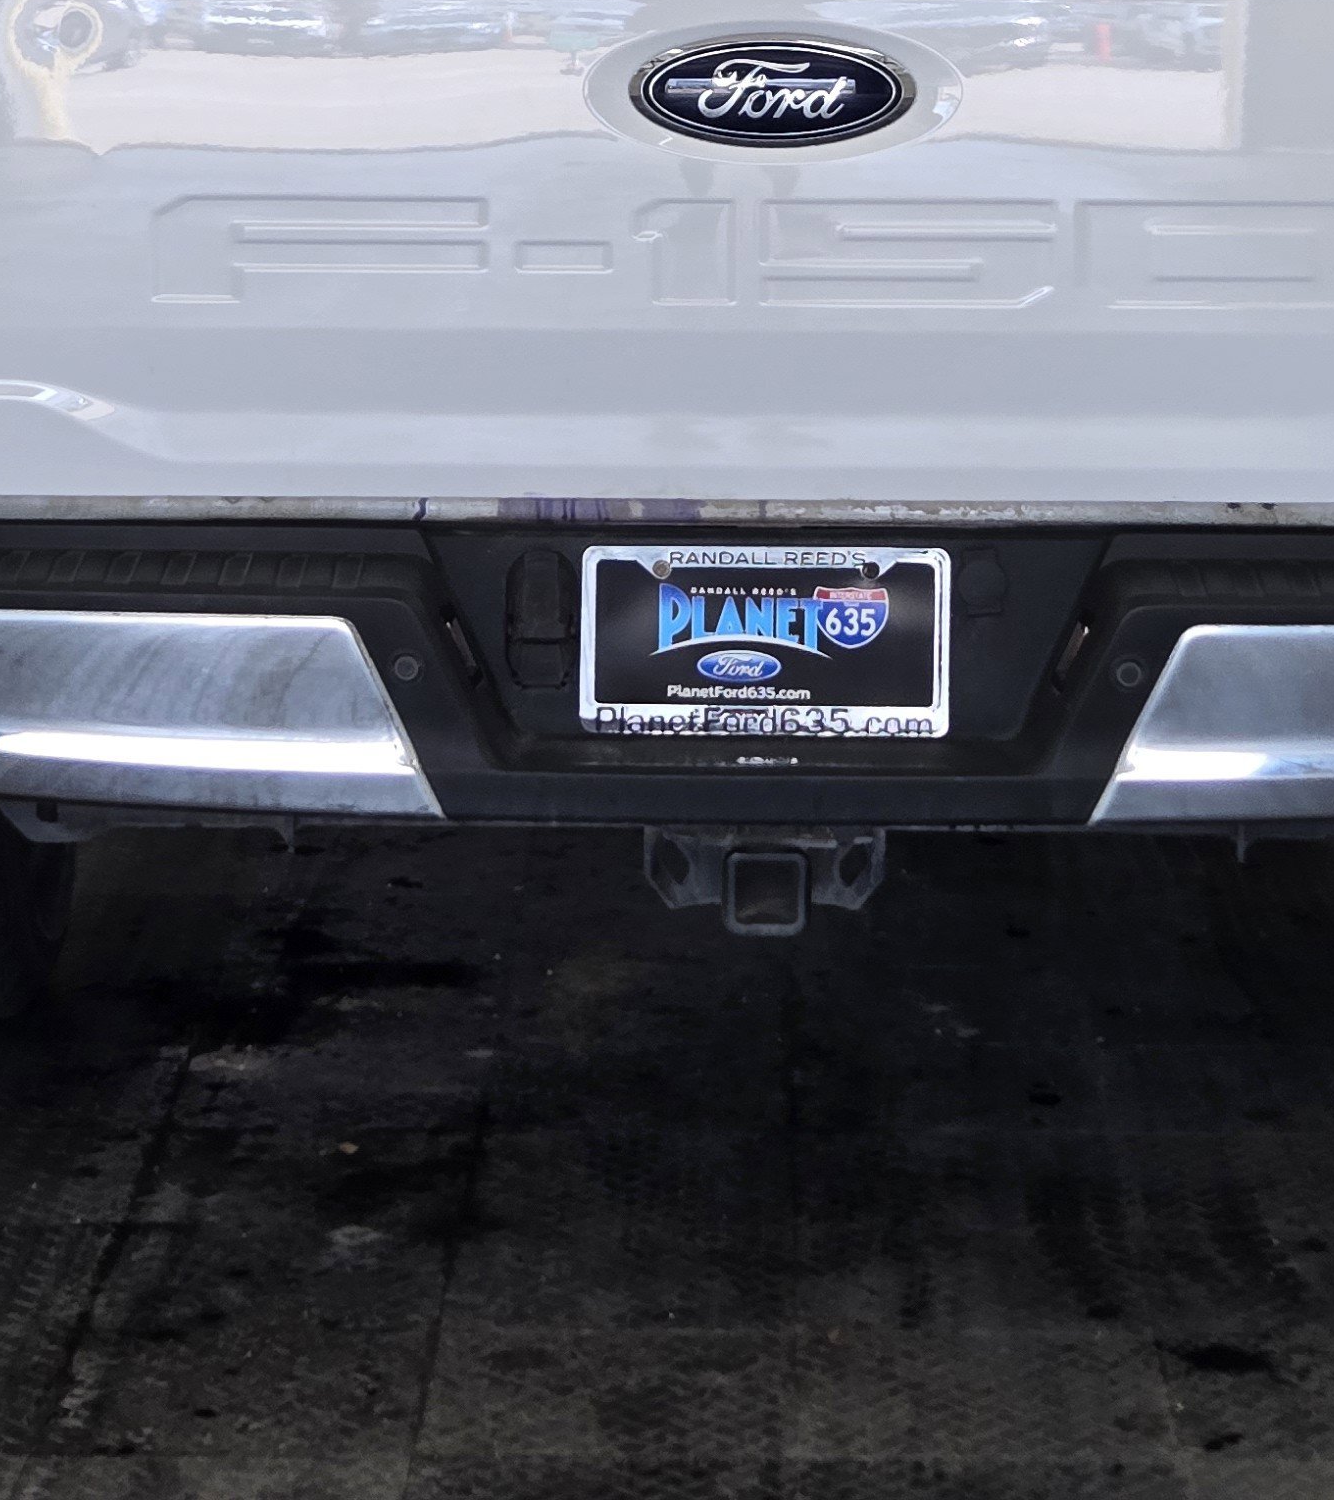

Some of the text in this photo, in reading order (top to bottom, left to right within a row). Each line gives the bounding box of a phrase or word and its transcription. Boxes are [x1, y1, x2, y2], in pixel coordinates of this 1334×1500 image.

[698, 59, 845, 119] Ford
[669, 551, 866, 567] RANDALL REED'S
[658, 583, 824, 652] PLANET
[824, 608, 876, 637] 635
[712, 656, 764, 678] Ford
[667, 684, 811, 700] PlanetFord635.com
